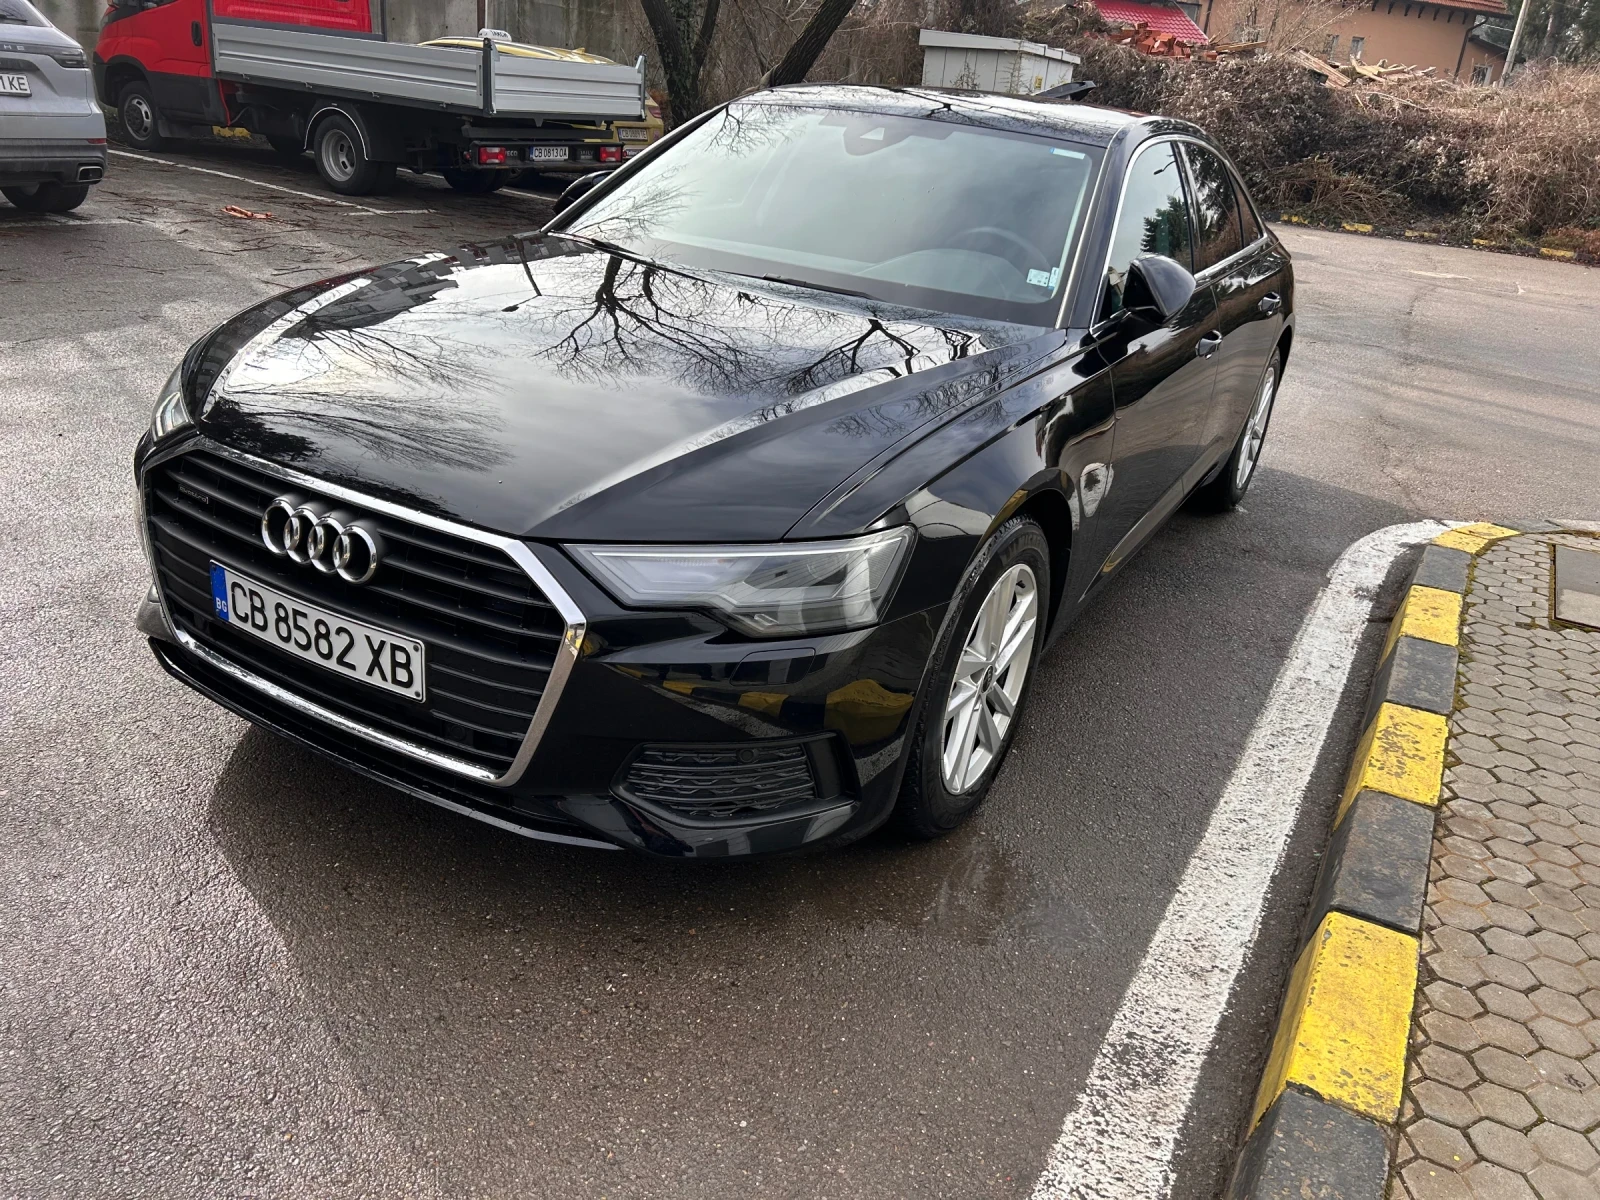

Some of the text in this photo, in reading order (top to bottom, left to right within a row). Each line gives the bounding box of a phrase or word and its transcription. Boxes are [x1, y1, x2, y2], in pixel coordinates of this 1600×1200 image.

[7, 76, 28, 91] KE
[534, 148, 543, 158] CB
[215, 597, 228, 613] BG
[230, 581, 414, 689] CB 8582 XB
